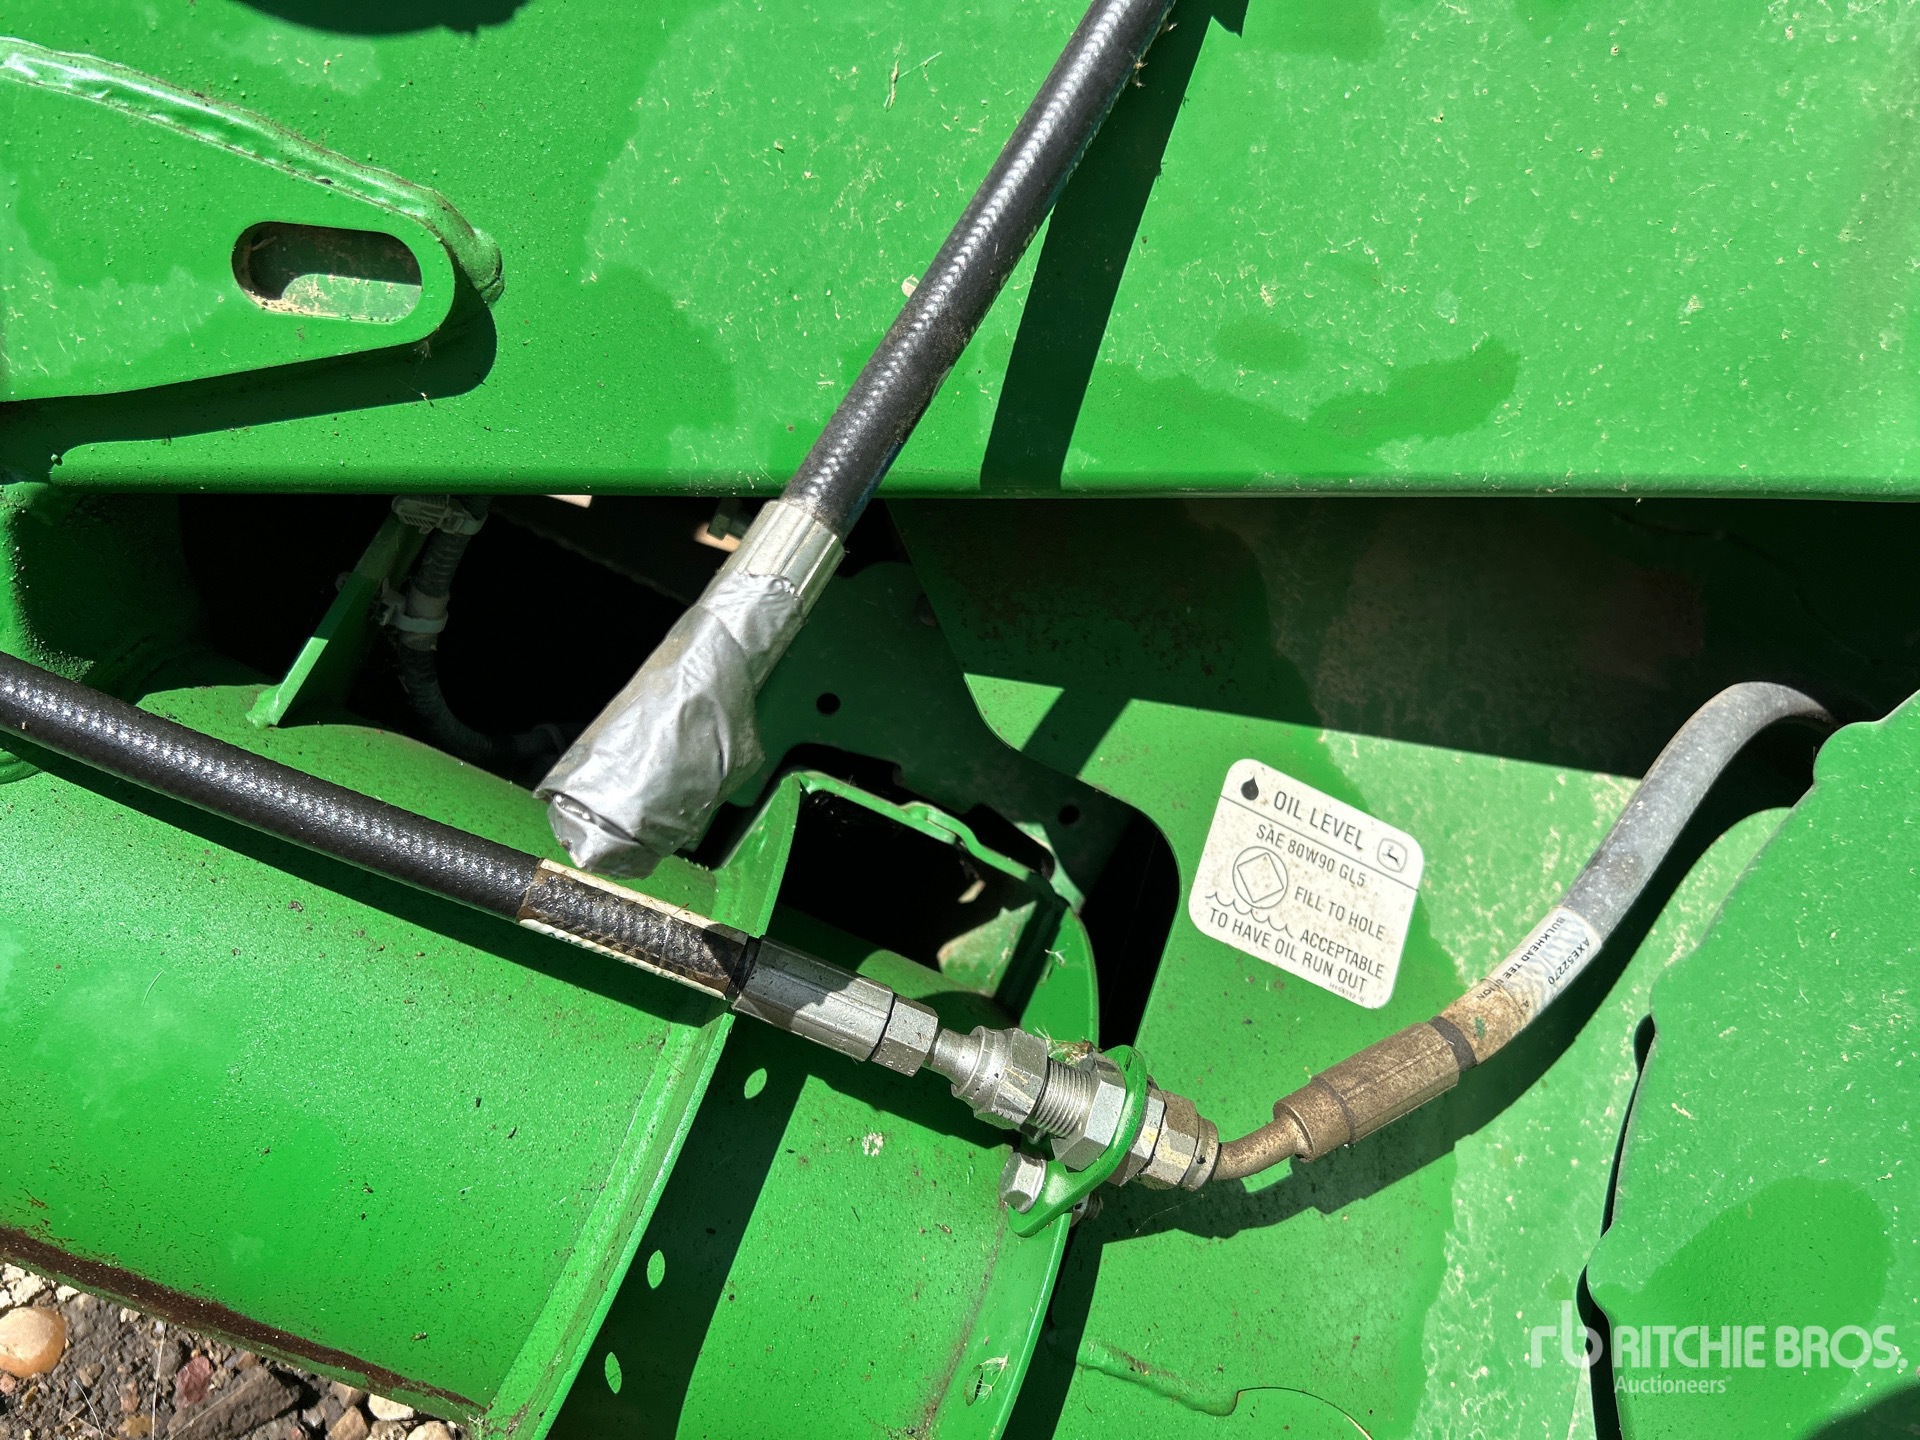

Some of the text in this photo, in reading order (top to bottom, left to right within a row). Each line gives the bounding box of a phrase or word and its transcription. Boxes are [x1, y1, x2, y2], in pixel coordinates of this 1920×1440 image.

[1273, 790, 1363, 850] OIL LEVEL
[1256, 824, 1366, 888] SAE 80W90 GL5
[1294, 886, 1386, 941] FILL TO HOLE
[1521, 916, 1566, 962] BULKHEAD
[1210, 907, 1228, 928] TO
[1232, 918, 1271, 948] HAVE
[1274, 938, 1297, 962] OIL
[1302, 951, 1335, 978] RUN
[1337, 967, 1368, 993] OUT
[1299, 929, 1385, 980] ACCEPTABLE
[1502, 963, 1522, 979] TEE
[1547, 936, 1591, 985] AXE52270
